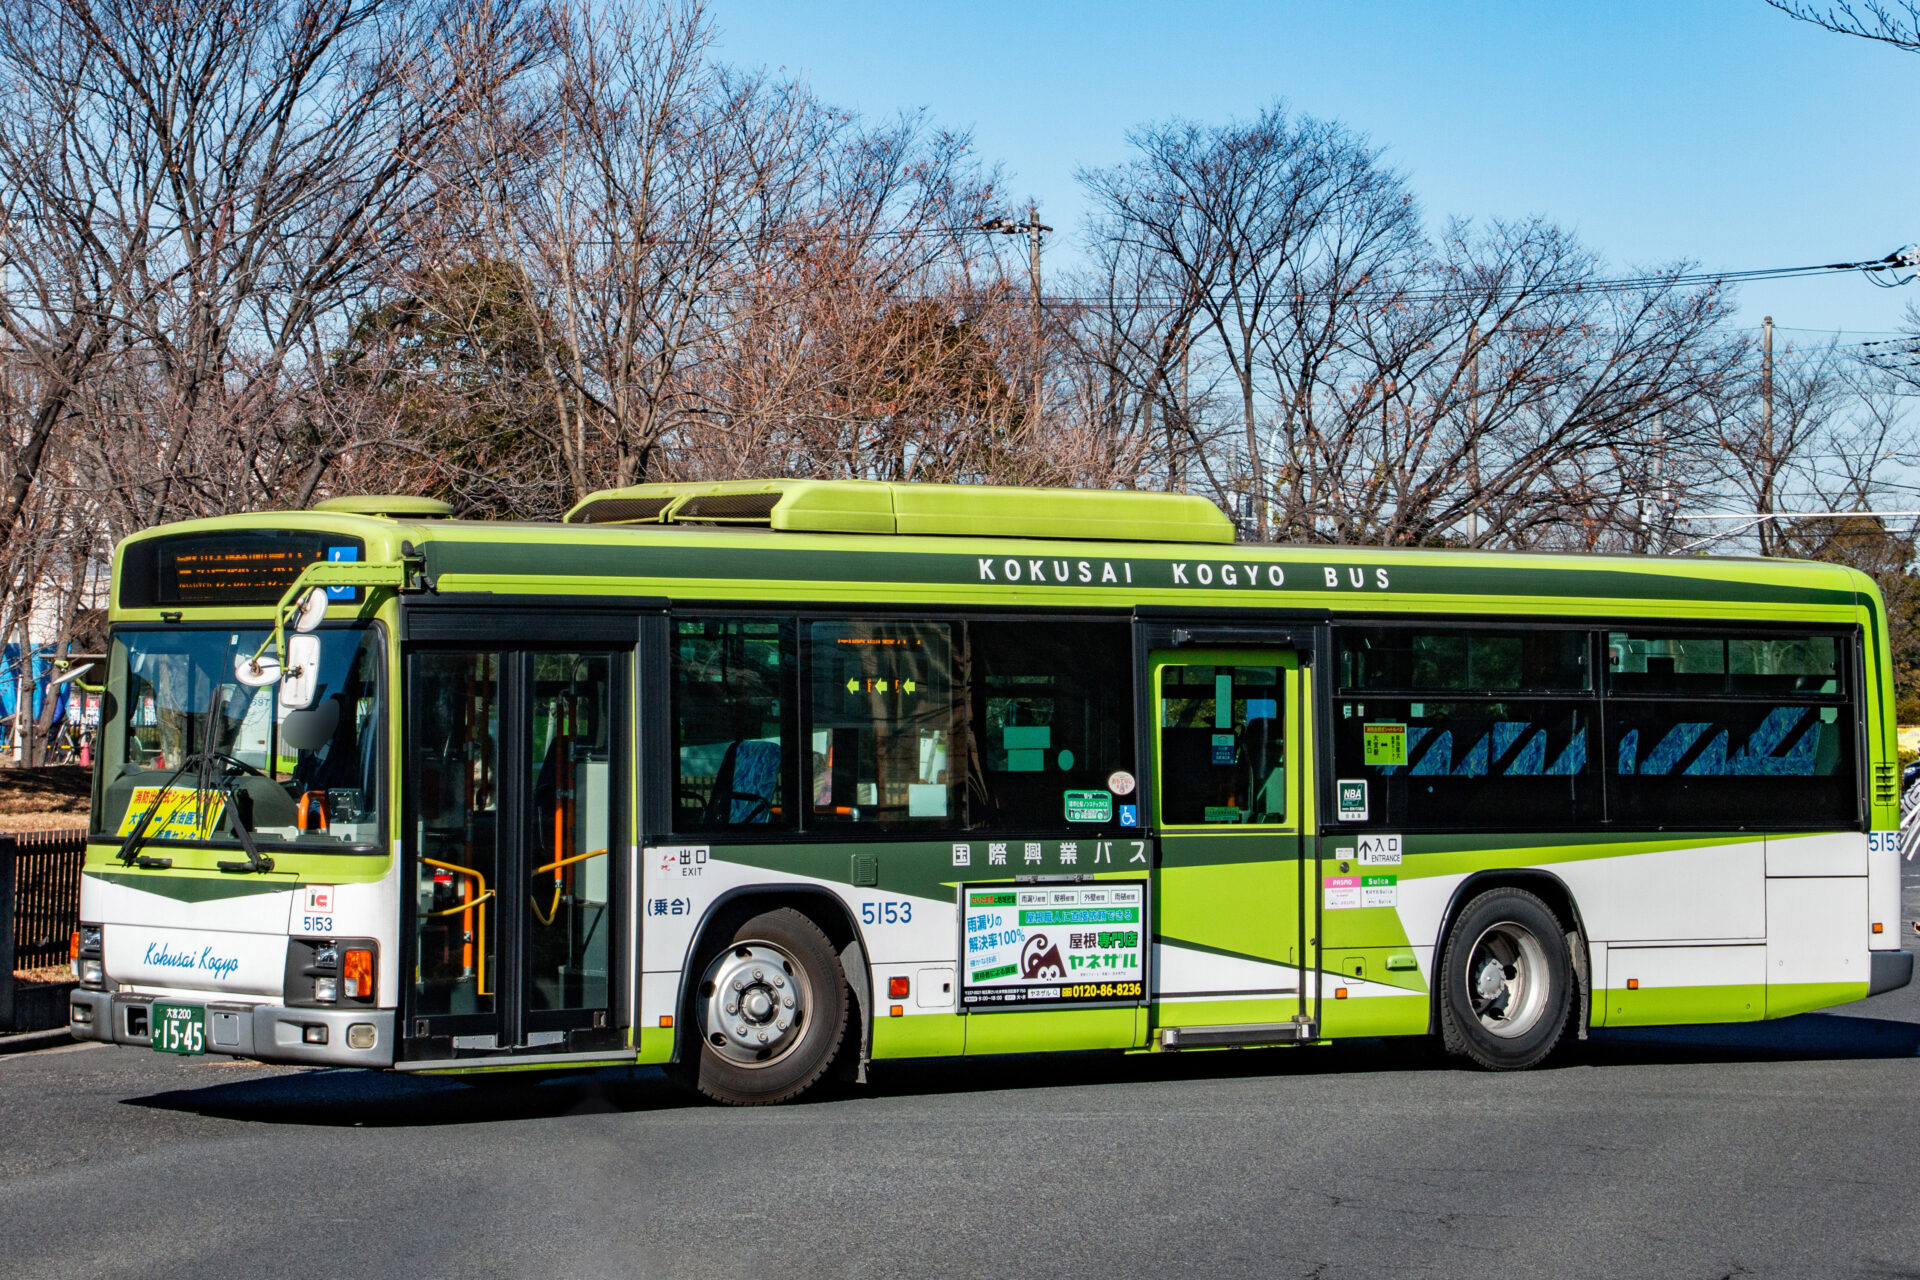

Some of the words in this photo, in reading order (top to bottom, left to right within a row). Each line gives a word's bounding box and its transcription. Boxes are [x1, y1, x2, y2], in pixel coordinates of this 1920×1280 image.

[978, 558, 1133, 583] KOKUSAI
[1172, 563, 1285, 587] KOGYO
[1324, 566, 1390, 589] BUS
[1343, 789, 1362, 799] NBA
[1375, 838, 1397, 852] 入口
[680, 849, 706, 865] 出口
[952, 841, 1146, 866] 国際興業バス
[1371, 854, 1401, 863] ENTRANCE
[682, 867, 703, 877] EXIT
[647, 897, 691, 917] (乗合)
[862, 902, 912, 924] 5153
[304, 916, 333, 931] 5153
[967, 914, 1003, 933] 雨漏りの
[1025, 909, 1133, 924] 屋根職人に直接依頼できる
[968, 928, 1026, 953] 解決率100%
[1069, 931, 1138, 949] 屋根専門店
[144, 943, 196, 968] Kokusai
[198, 946, 239, 981] Kogyo
[1068, 953, 1139, 970] ヤネザル
[1030, 989, 1051, 997] ヤネザル
[1072, 983, 1141, 998] 0120-86-8236
